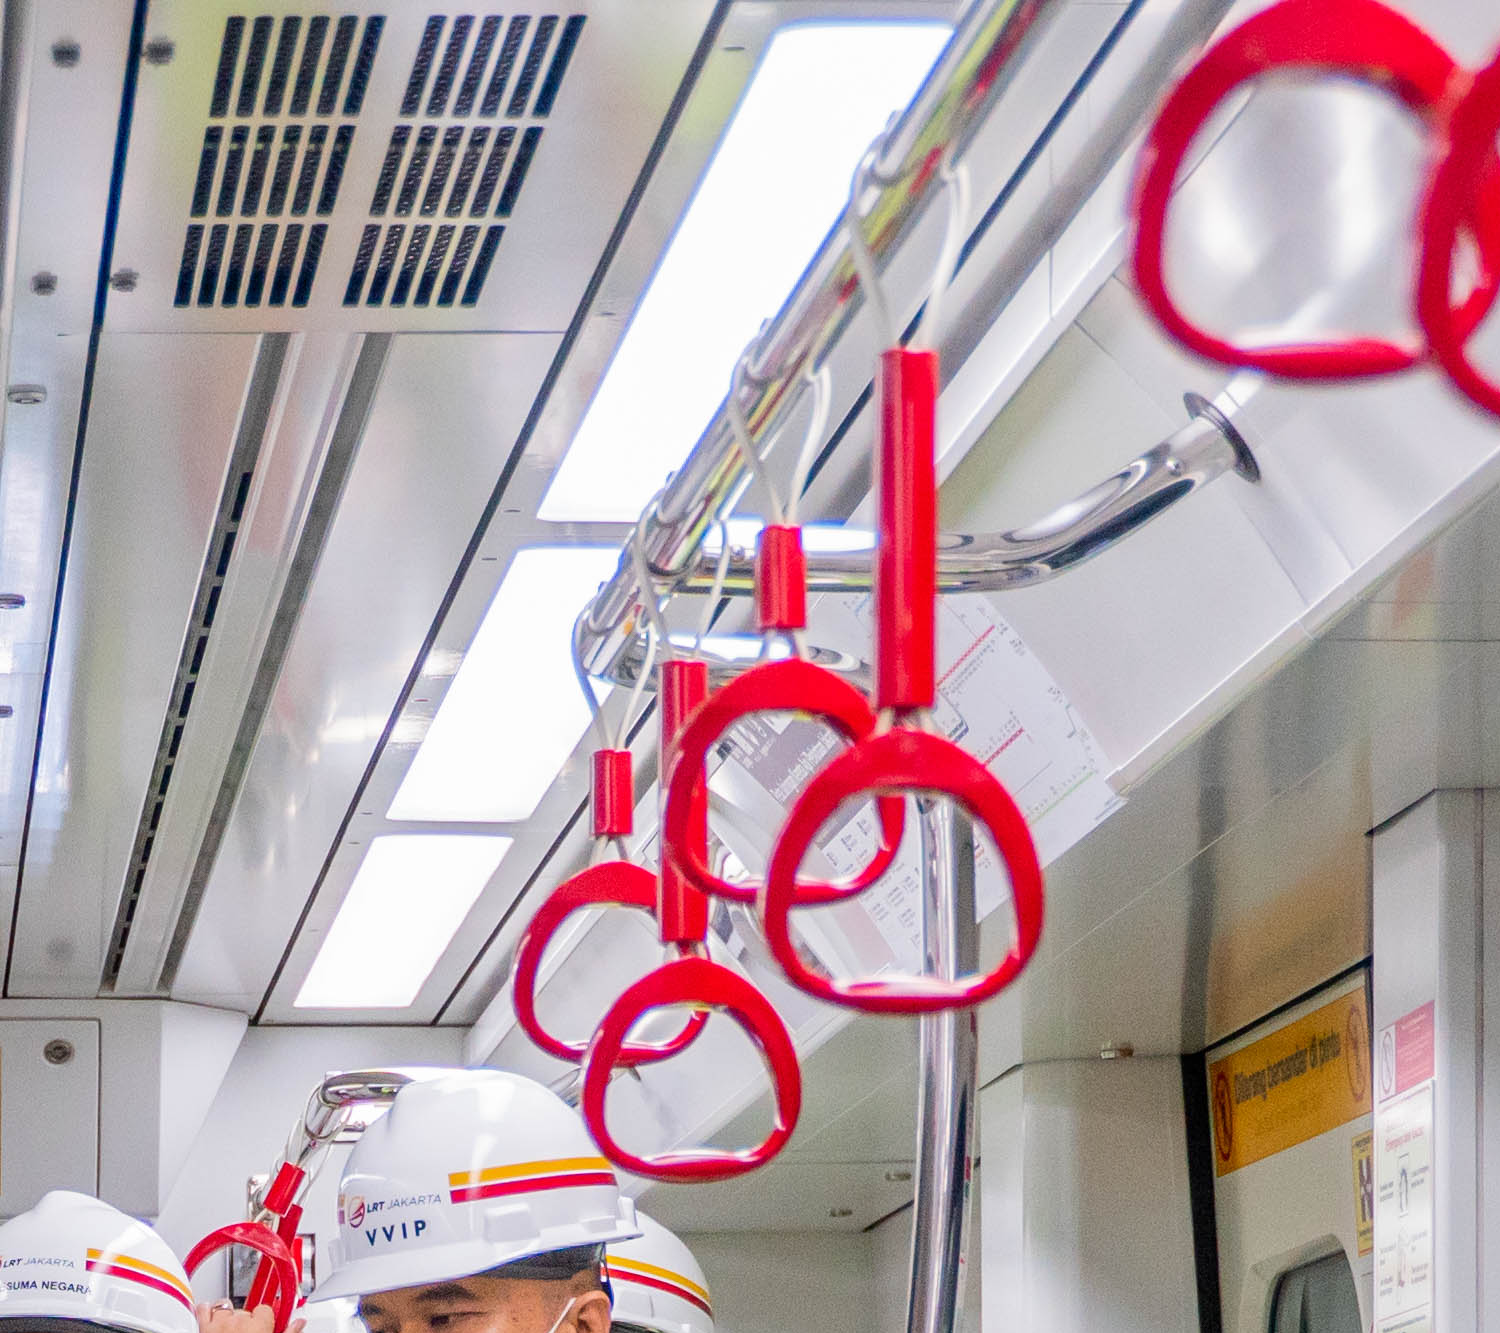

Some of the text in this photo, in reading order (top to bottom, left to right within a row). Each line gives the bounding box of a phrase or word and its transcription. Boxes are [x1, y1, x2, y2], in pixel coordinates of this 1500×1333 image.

[367, 1193, 442, 1214] LRT JAKARTA
[365, 1219, 427, 1247] VVIP
[3, 1257, 75, 1270] LRT JAKARTA
